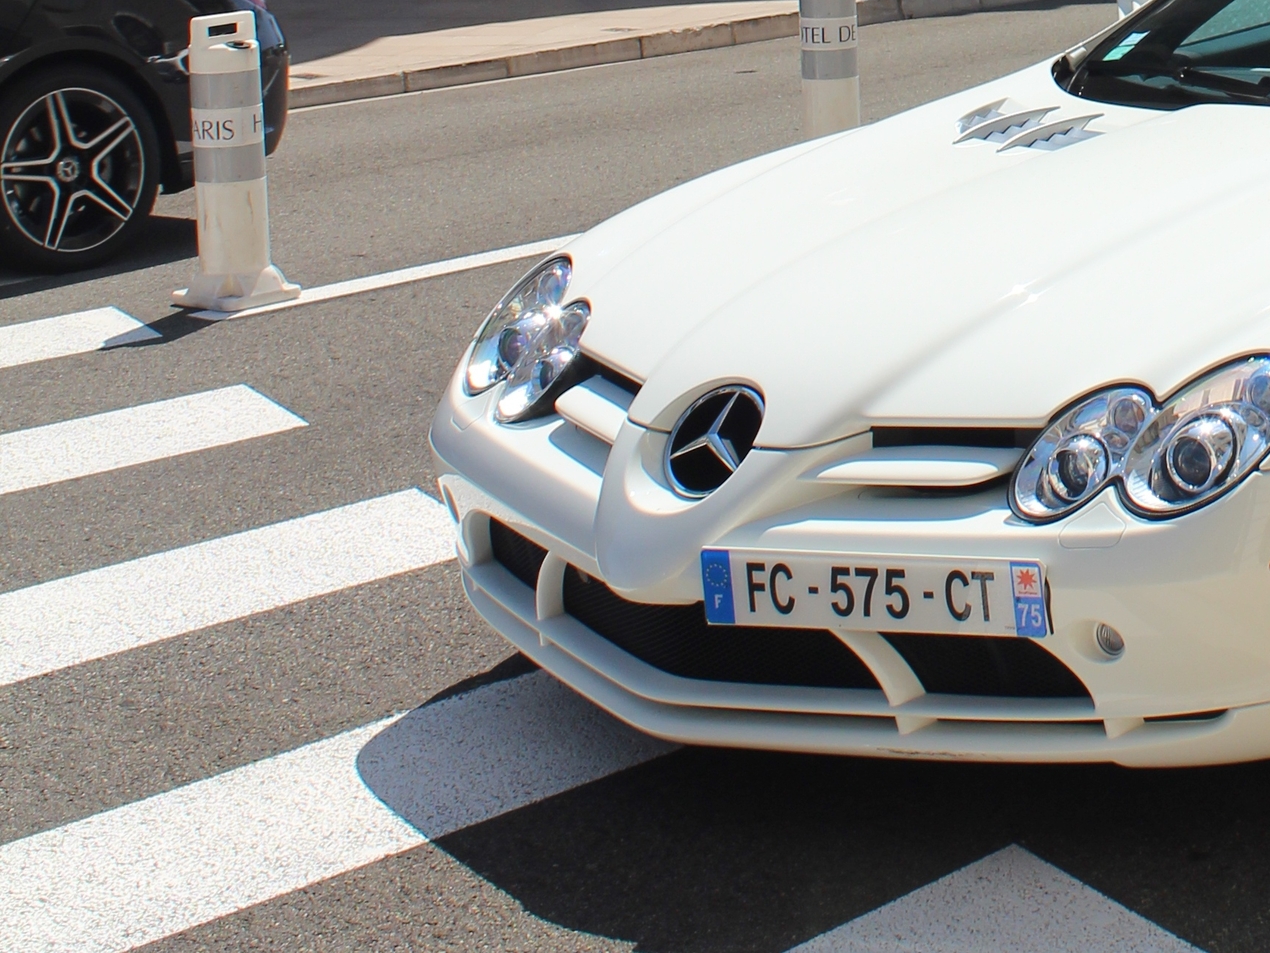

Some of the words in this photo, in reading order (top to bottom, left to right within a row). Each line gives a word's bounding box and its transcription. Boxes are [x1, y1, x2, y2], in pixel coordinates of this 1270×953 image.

[801, 27, 831, 44] TEL
[839, 25, 856, 43] DE
[714, 594, 723, 609] F
[1017, 603, 1042, 627] 75
